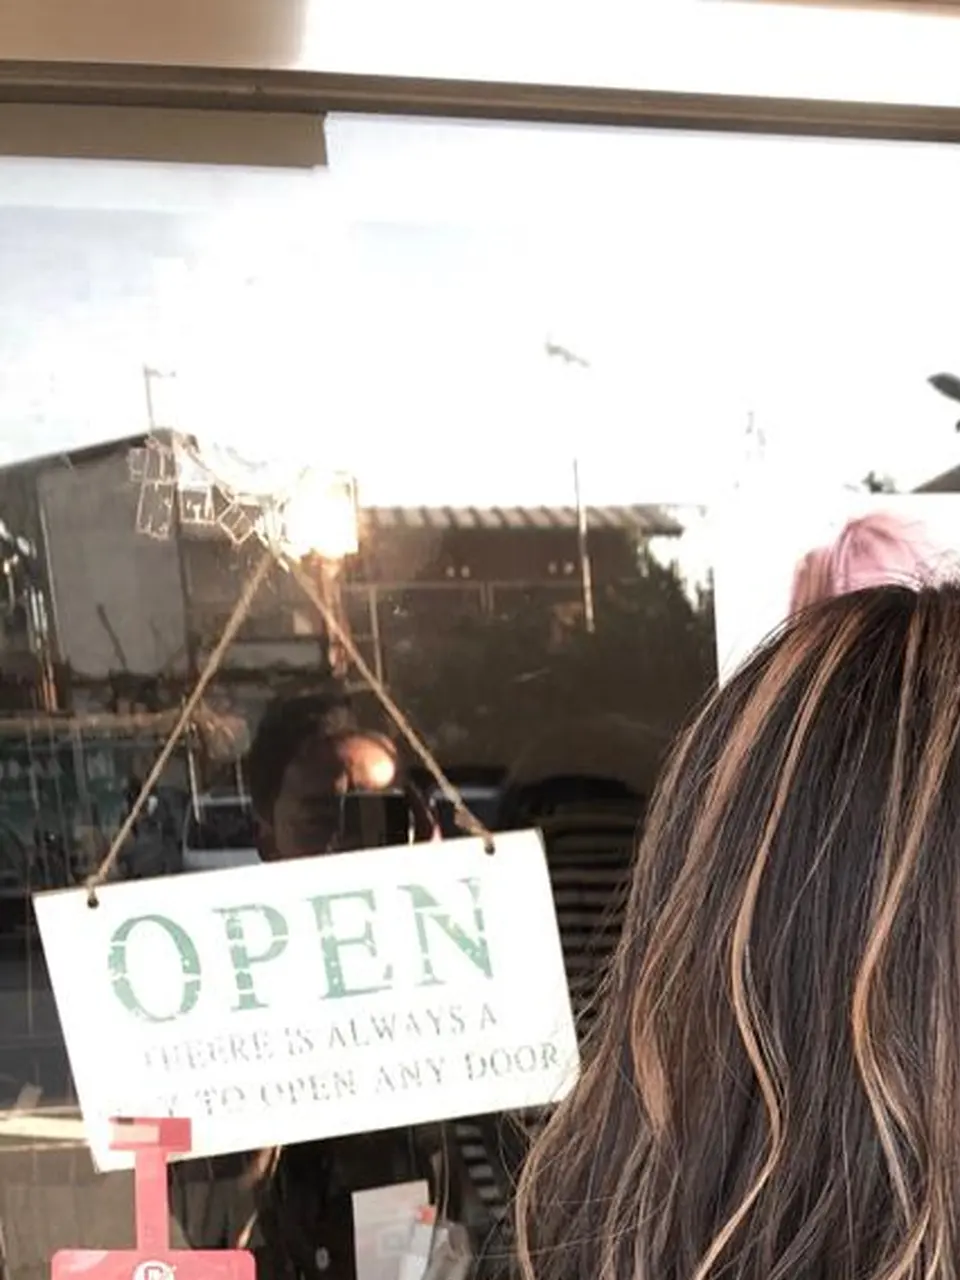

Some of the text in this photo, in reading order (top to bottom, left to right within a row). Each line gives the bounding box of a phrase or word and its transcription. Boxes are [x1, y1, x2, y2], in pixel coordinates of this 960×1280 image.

[107, 877, 496, 1024] OPEN
[327, 1004, 466, 1051] ALWAYS
[479, 1001, 499, 1031] A
[194, 1084, 246, 1116] TO
[260, 1067, 358, 1110] OPEN
[374, 1056, 446, 1094] ANY
[464, 1041, 560, 1081] DOOR
